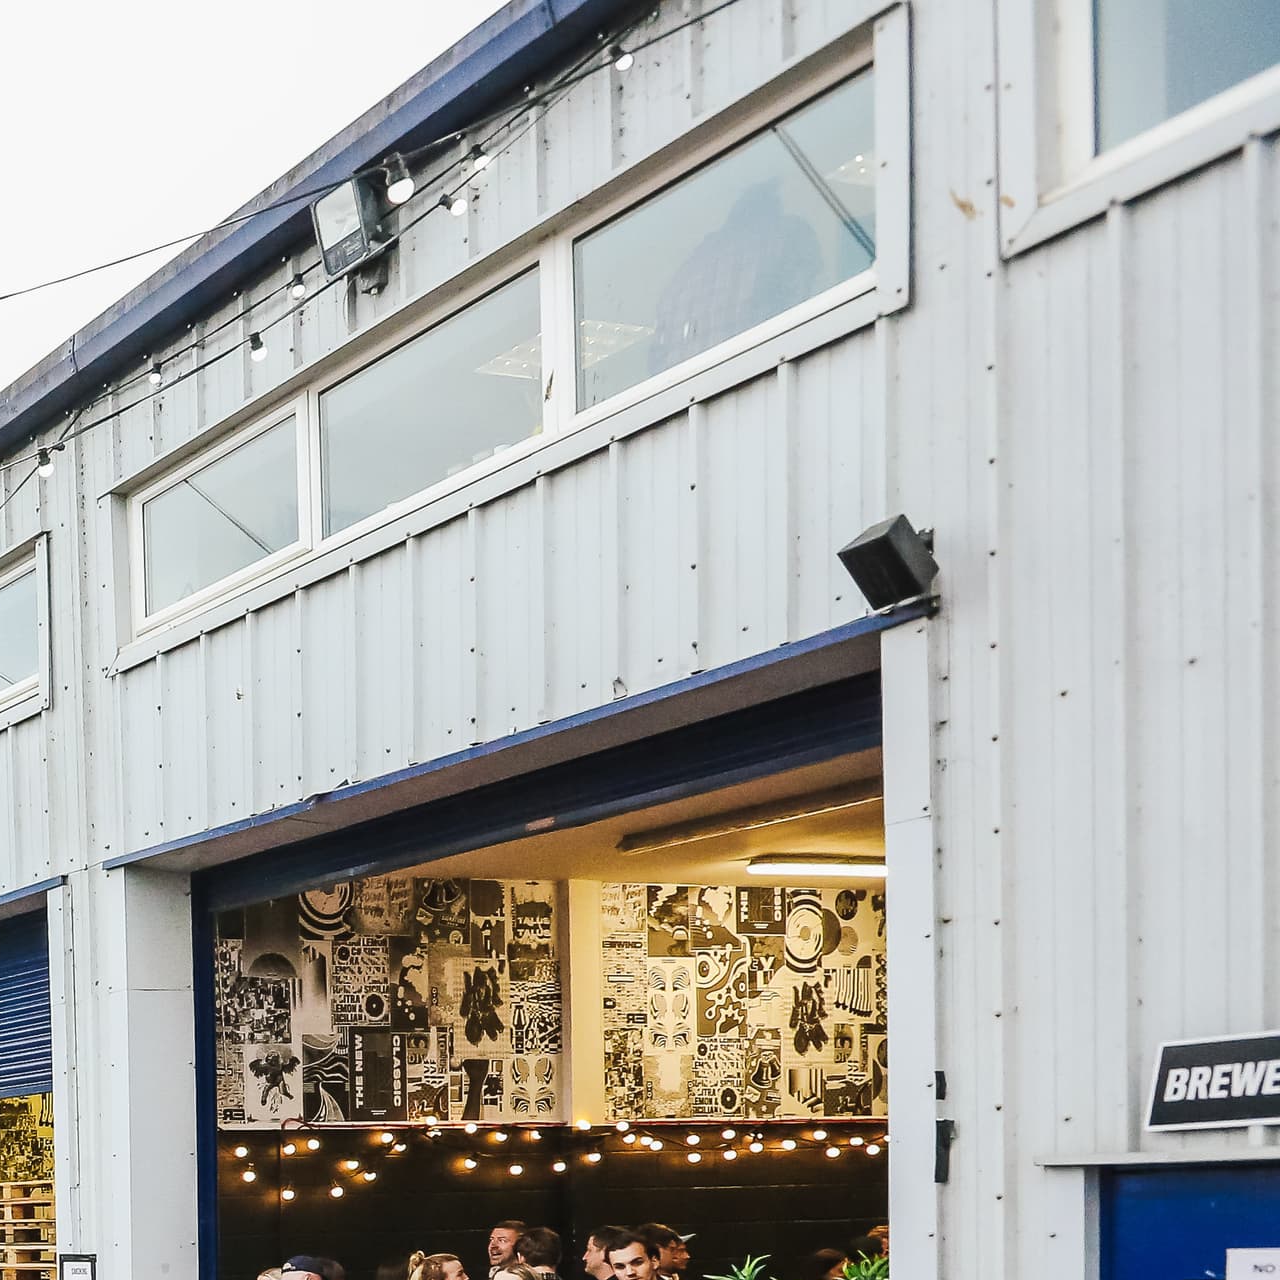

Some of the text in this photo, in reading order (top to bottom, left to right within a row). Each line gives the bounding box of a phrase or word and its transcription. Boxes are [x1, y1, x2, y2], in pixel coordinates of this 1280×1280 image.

[354, 1034, 364, 1109] THE NEW
[392, 1035, 401, 1107] CLASSIC
[1163, 1059, 1280, 1102] BREWE
